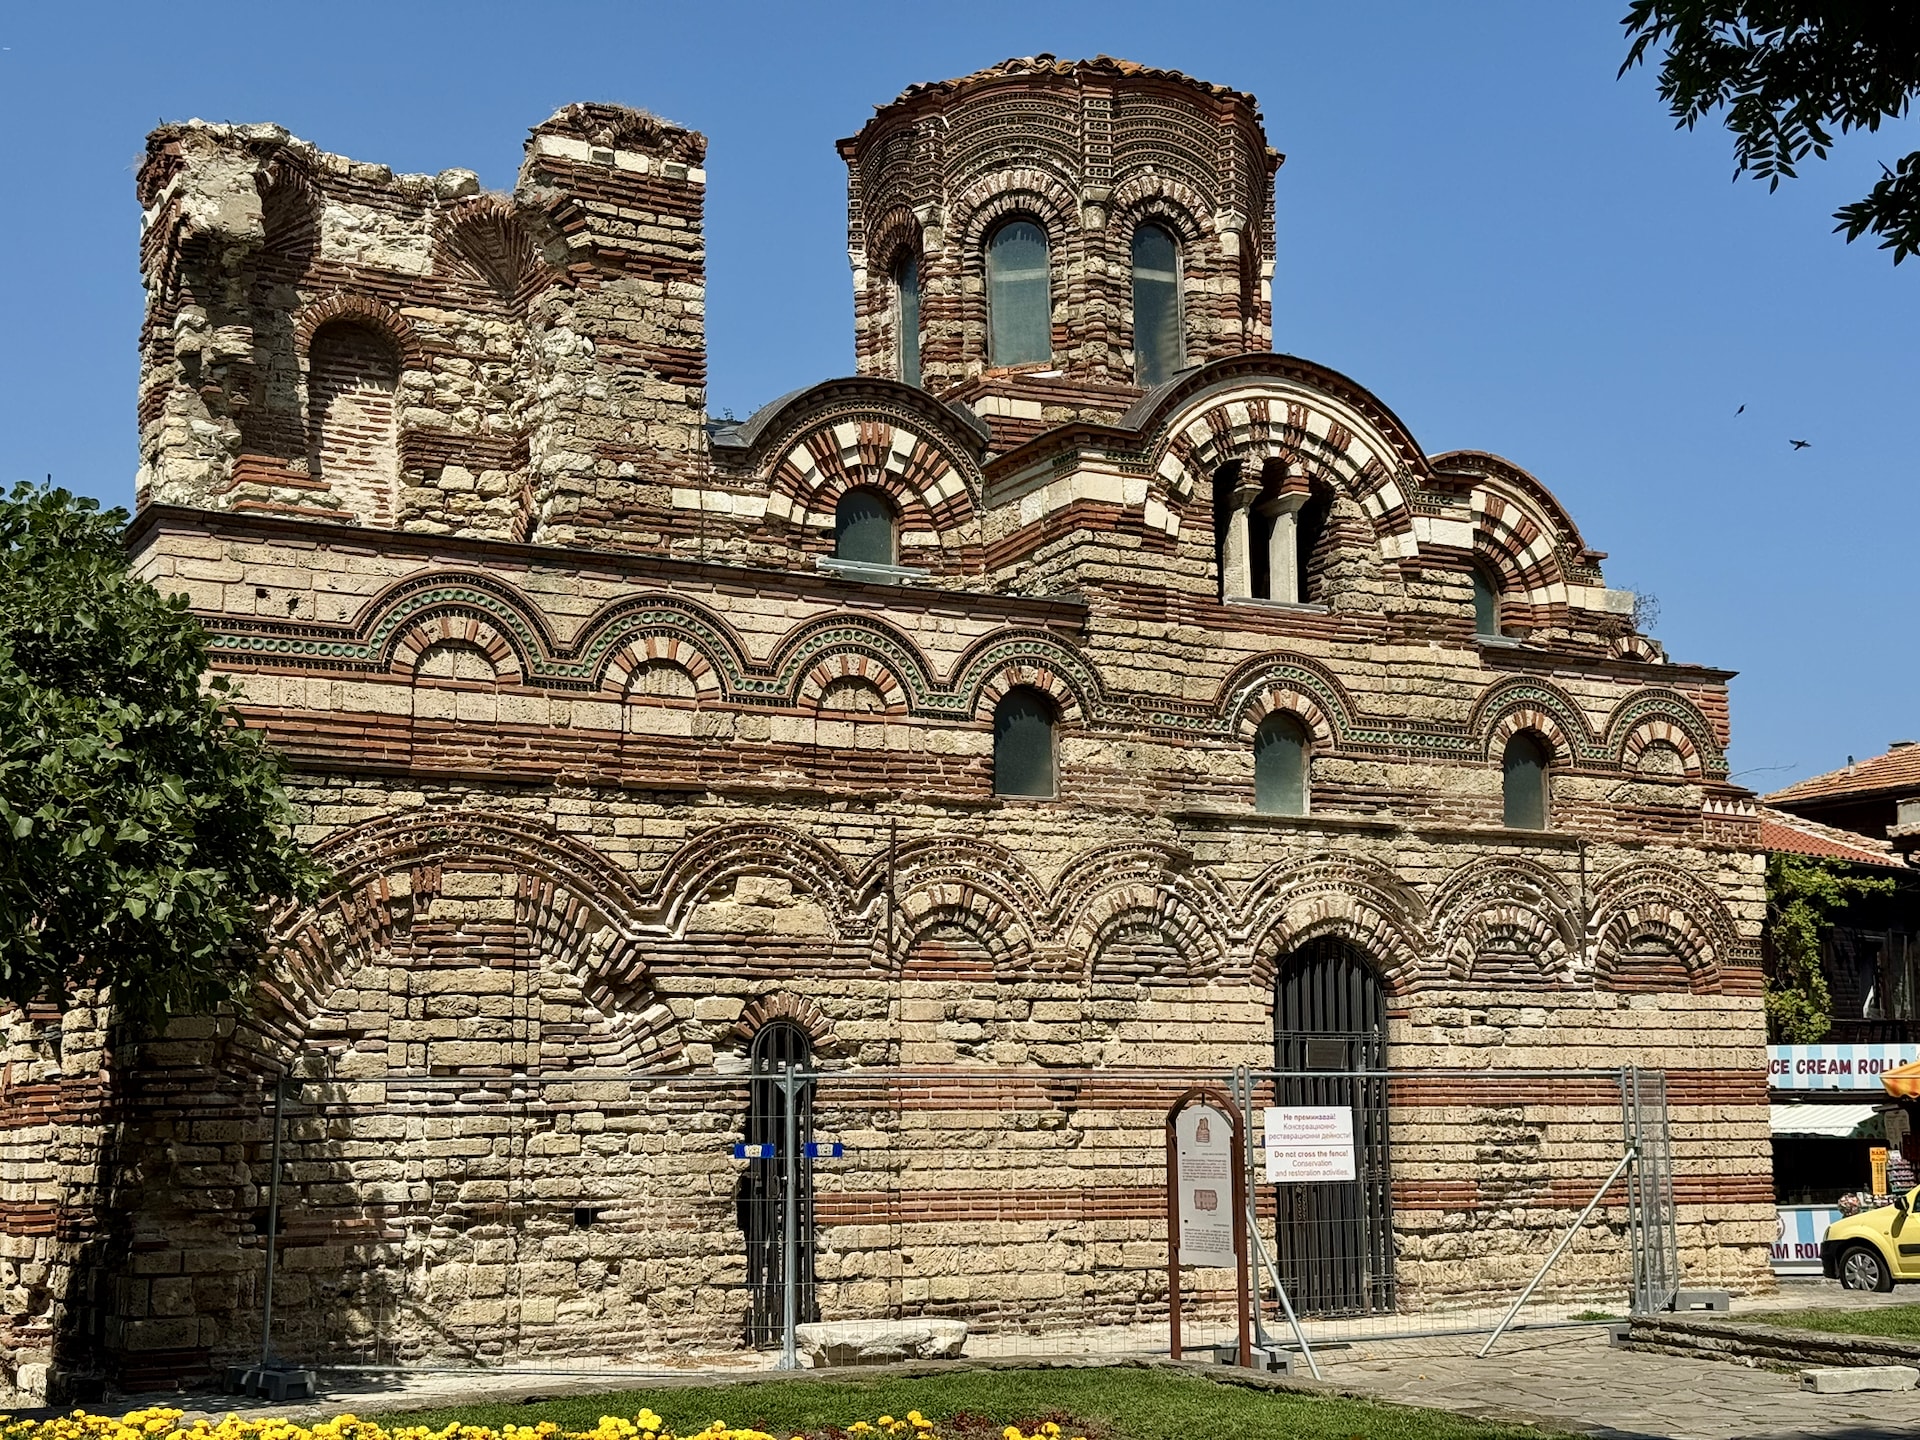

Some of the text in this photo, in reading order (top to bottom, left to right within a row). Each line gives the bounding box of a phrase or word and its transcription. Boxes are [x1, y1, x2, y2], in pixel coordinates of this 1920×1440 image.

[1796, 1059, 1852, 1075] CREAM
[1274, 1150, 1284, 1158] Do
[1329, 1149, 1348, 1157] fence!
[1292, 1159, 1332, 1167] Conservation
[1288, 1169, 1321, 1177] restoration
[1322, 1168, 1349, 1176] activities.
